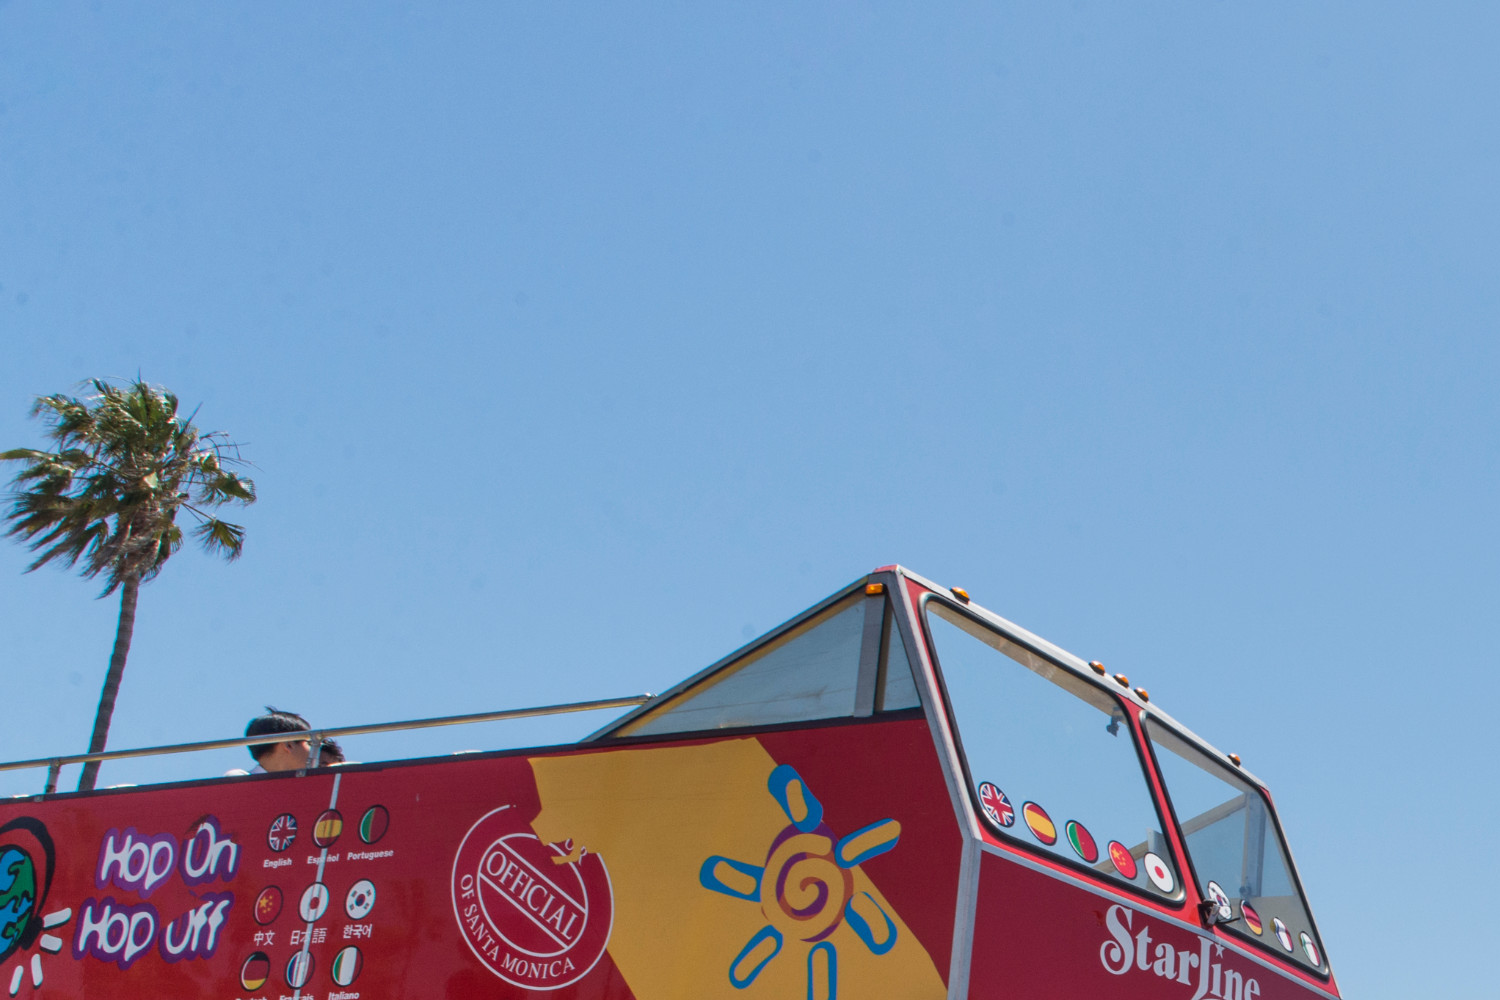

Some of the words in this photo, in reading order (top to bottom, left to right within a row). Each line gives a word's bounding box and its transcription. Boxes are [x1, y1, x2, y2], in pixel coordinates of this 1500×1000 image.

[102, 834, 174, 890] Hop
[263, 858, 292, 868] English
[307, 854, 339, 866] Espñol
[347, 849, 394, 861] Portuguese
[461, 874, 475, 899] OF
[486, 851, 578, 940] OFFICIAL
[79, 905, 155, 962] Hop
[253, 929, 275, 946] 中文
[343, 923, 373, 939] 한국어
[464, 903, 500, 961] SANTA
[501, 952, 575, 979] MONICA
